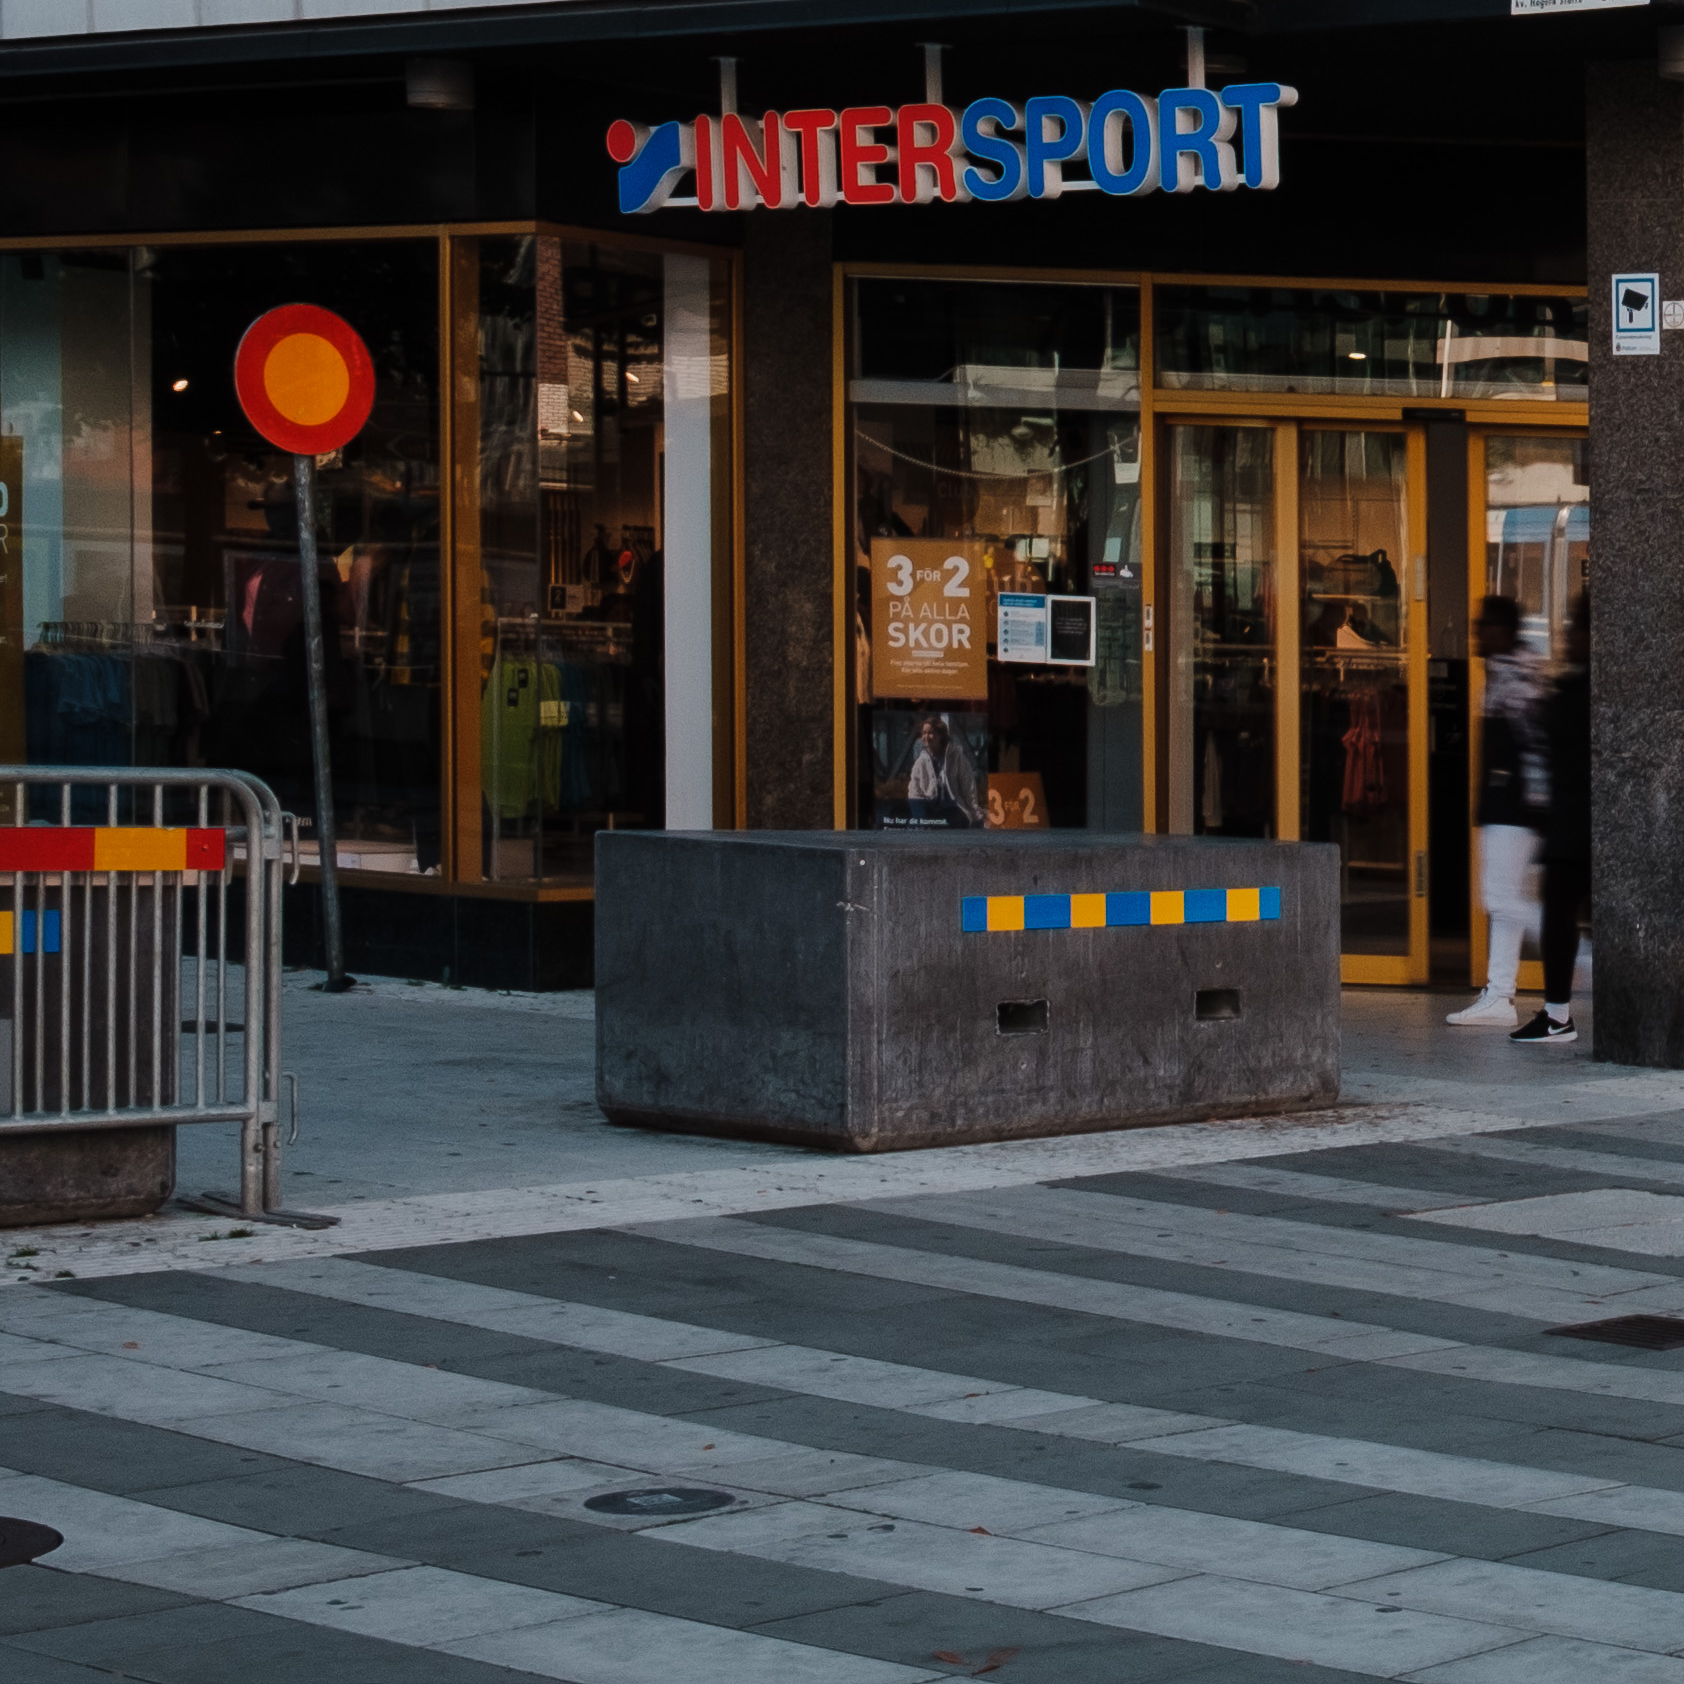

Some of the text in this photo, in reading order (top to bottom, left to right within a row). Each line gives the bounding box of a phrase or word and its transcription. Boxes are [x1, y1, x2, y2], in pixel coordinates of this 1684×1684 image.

[694, 81, 1298, 213] INTERSPORT
[887, 554, 970, 598] 3 FÖR 2
[889, 598, 971, 621] PÅ ALLA
[887, 621, 972, 650] SKOR
[988, 787, 1005, 826] 3
[1018, 787, 1039, 824] 2
